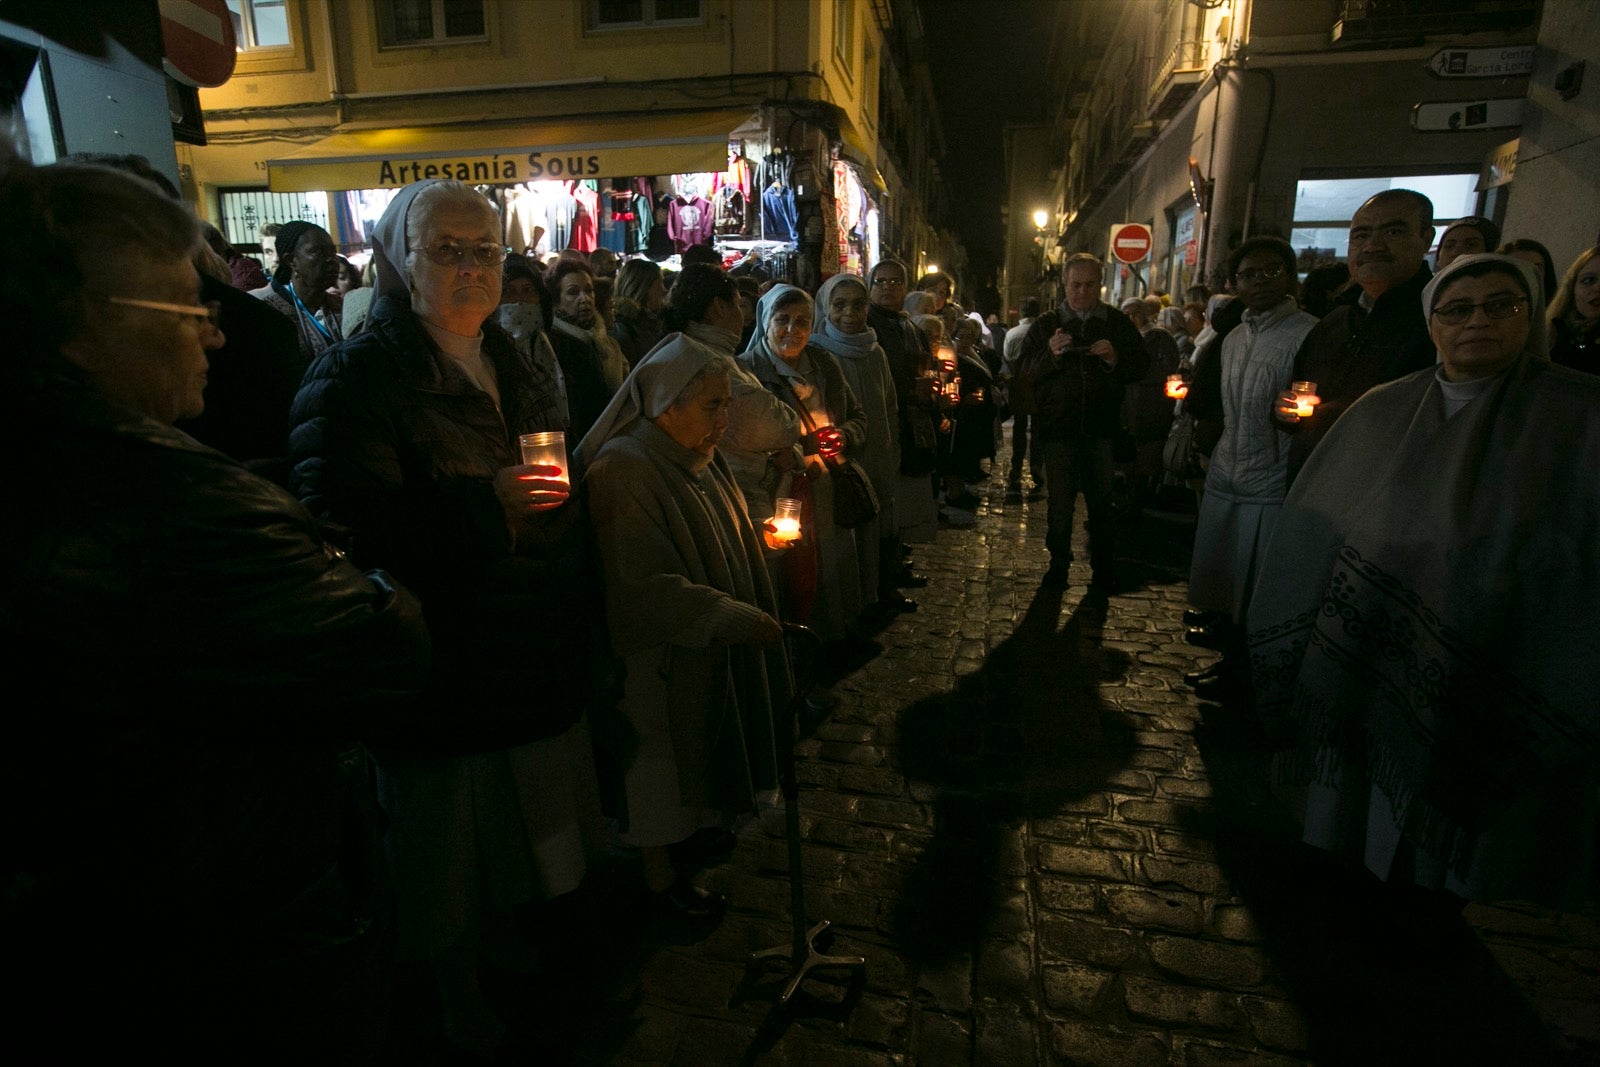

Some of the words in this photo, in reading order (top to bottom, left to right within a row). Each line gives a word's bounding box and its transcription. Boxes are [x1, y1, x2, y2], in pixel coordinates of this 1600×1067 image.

[1505, 60, 1533, 71] Lorc
[254, 161, 266, 171] 13
[379, 155, 517, 185] Artesanía
[528, 152, 600, 178] Sous
